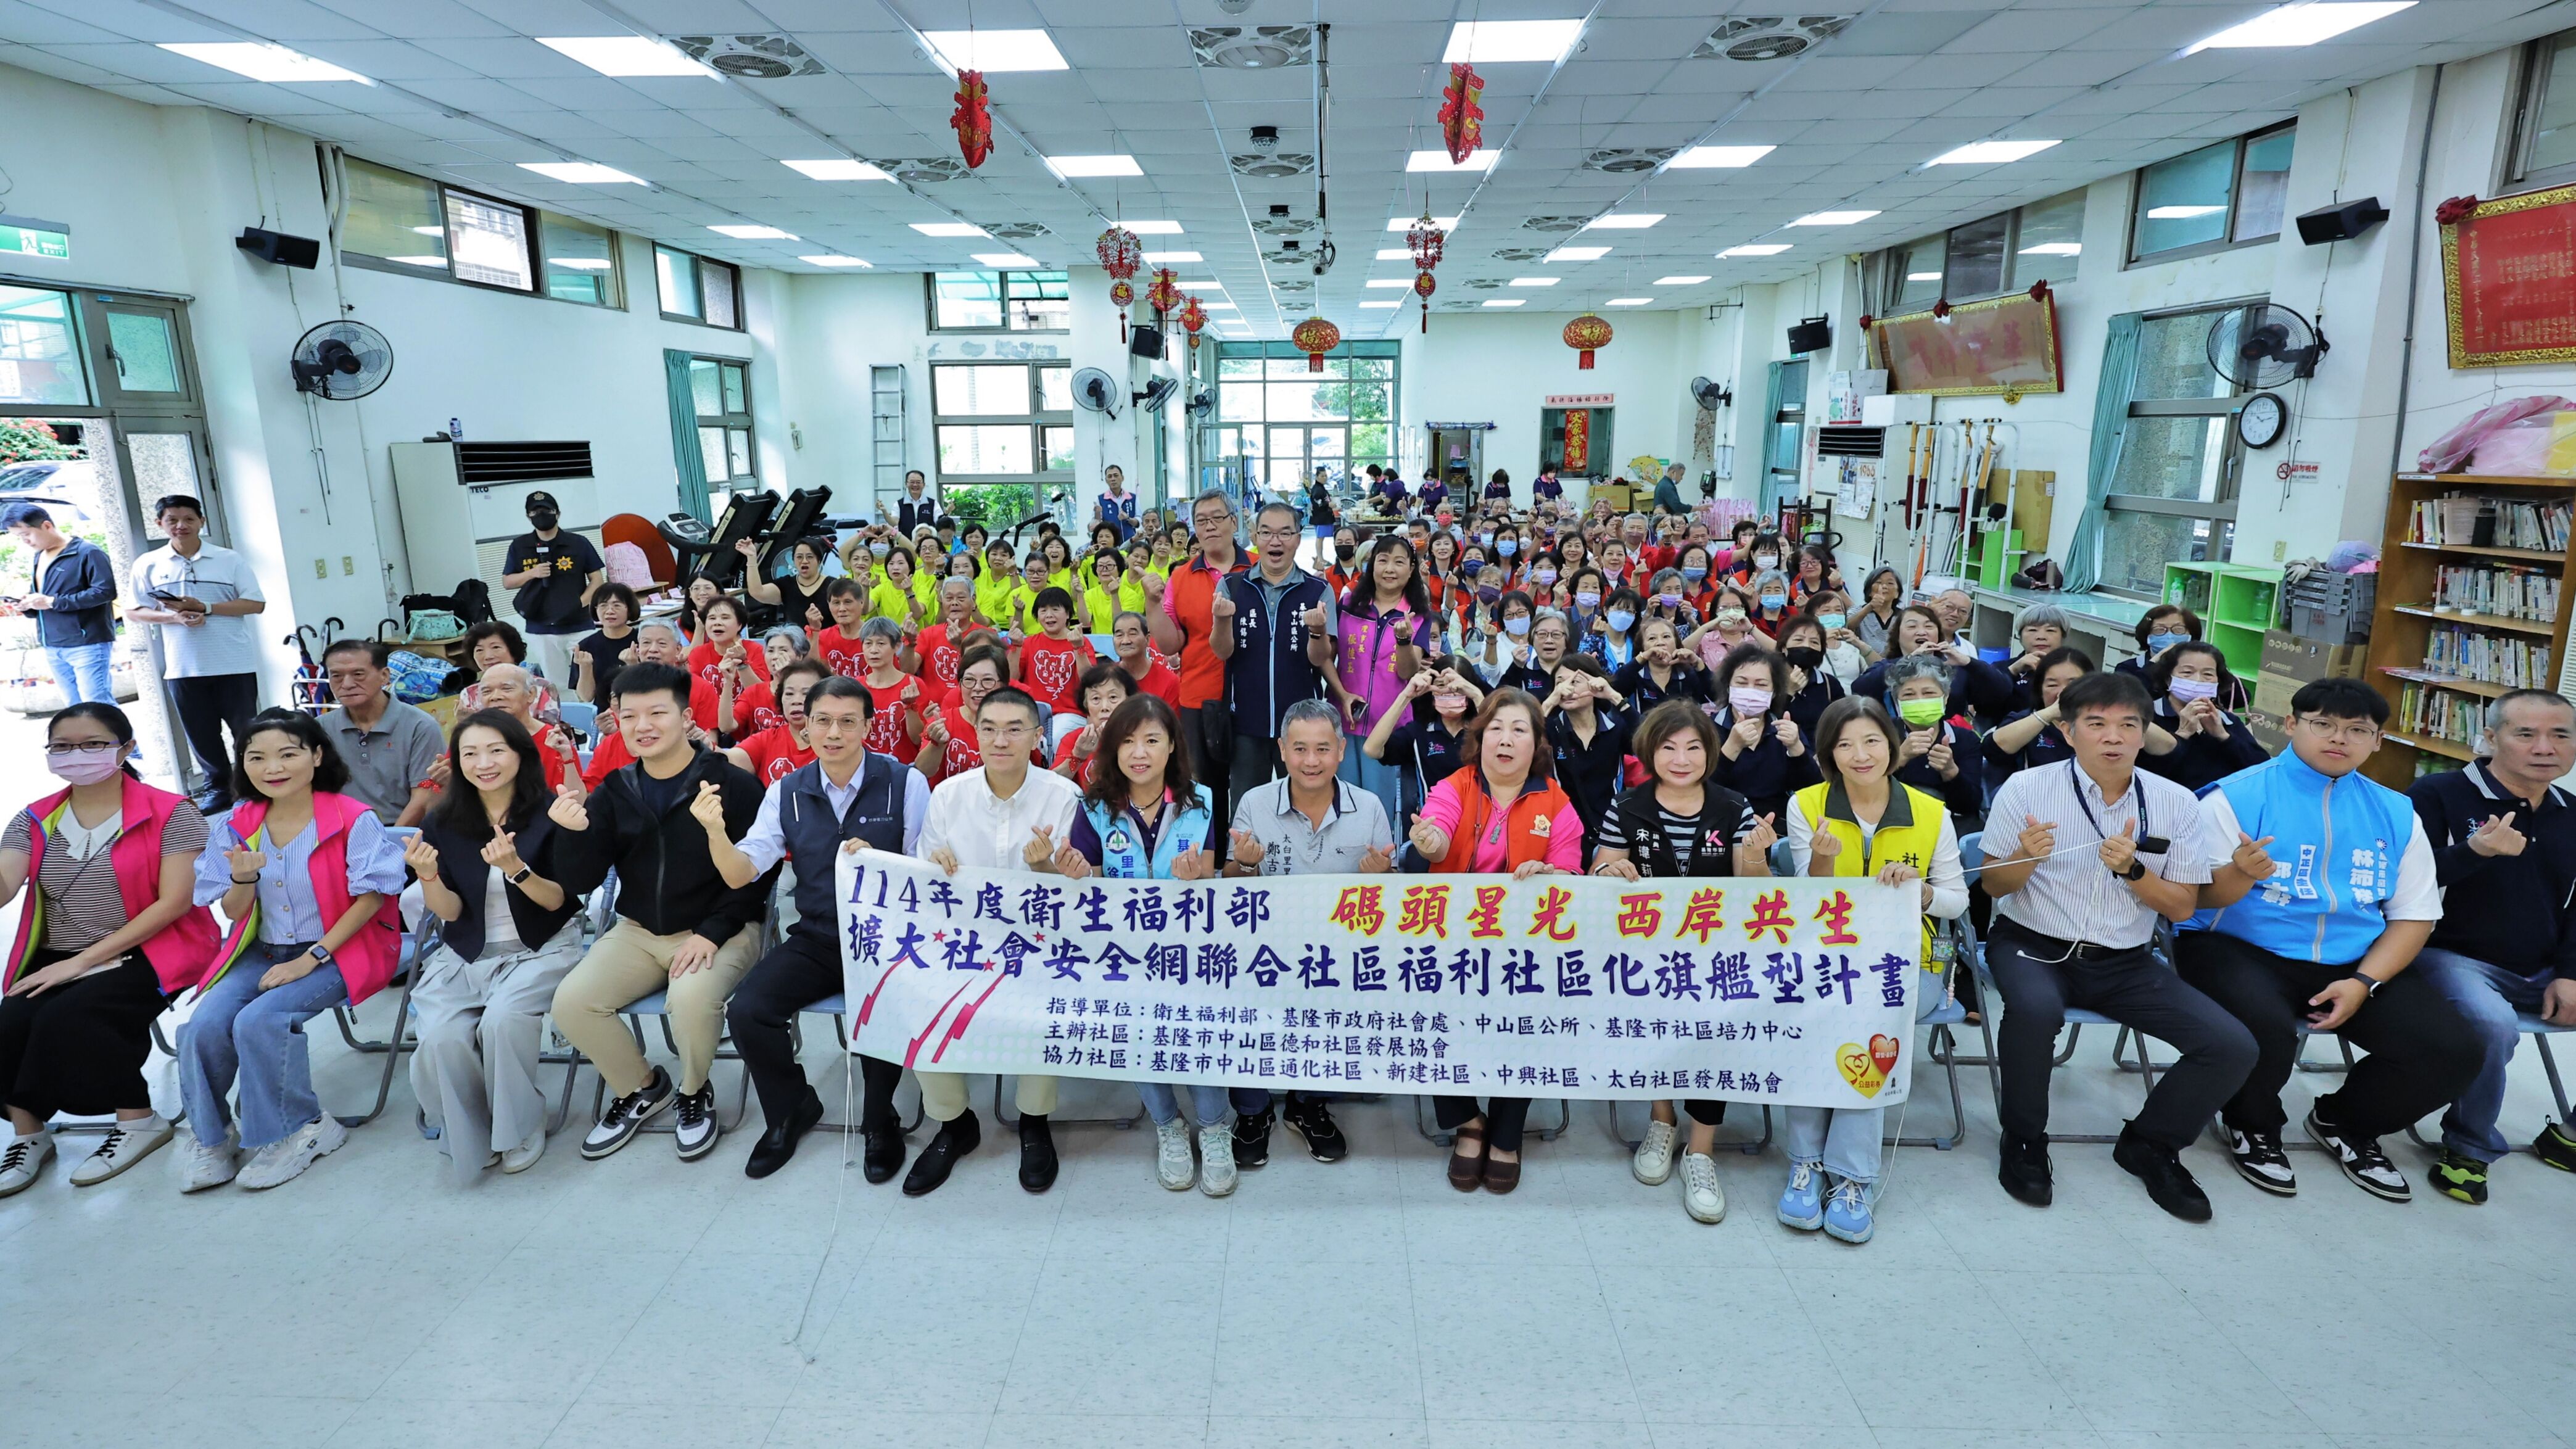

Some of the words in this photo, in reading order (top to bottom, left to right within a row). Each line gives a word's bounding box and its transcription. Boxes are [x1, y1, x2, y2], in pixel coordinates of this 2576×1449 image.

[1249, 608, 1257, 628] 區長
[1290, 609, 1298, 652] 中山區公所
[2296, 848, 2314, 896] 中正區主任
[848, 864, 1271, 935] 114年度衛生福利部
[1330, 884, 1579, 943] 碼頭星光
[1617, 888, 1864, 947] 西岸共生
[848, 914, 1912, 1009] 擴大社會安全網聯合社區福利社區化旗艦型計畫
